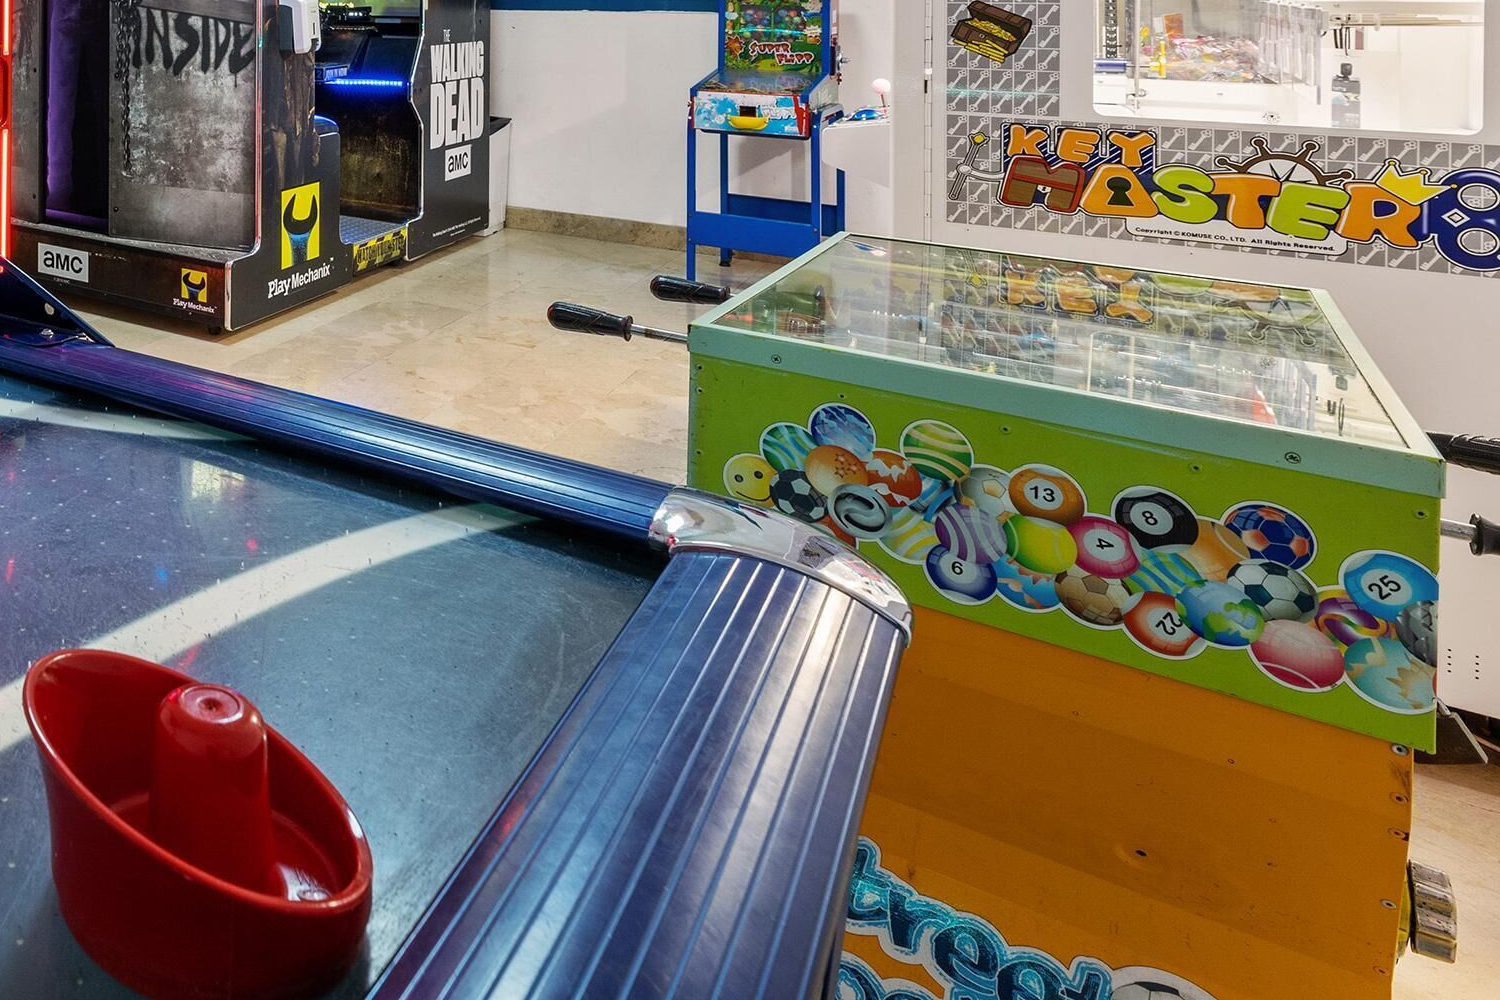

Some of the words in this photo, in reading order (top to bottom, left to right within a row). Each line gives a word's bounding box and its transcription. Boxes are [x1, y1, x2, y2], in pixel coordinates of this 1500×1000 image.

[430, 41, 484, 83] WALKING
[430, 77, 484, 150] DEAD
[1007, 123, 1157, 167] KEY
[1002, 155, 1422, 248] MASTER
[1135, 226, 1172, 236] Copyright
[1181, 231, 1213, 240] KOMUSE
[1265, 240, 1292, 248] Rights
[267, 273, 291, 299] Play
[1029, 485, 1056, 502] 13
[1141, 510, 1158, 526] 8
[1096, 537, 1114, 550] 4
[951, 561, 963, 575] 6
[1368, 575, 1401, 600] 25
[1155, 611, 1184, 635] 22
